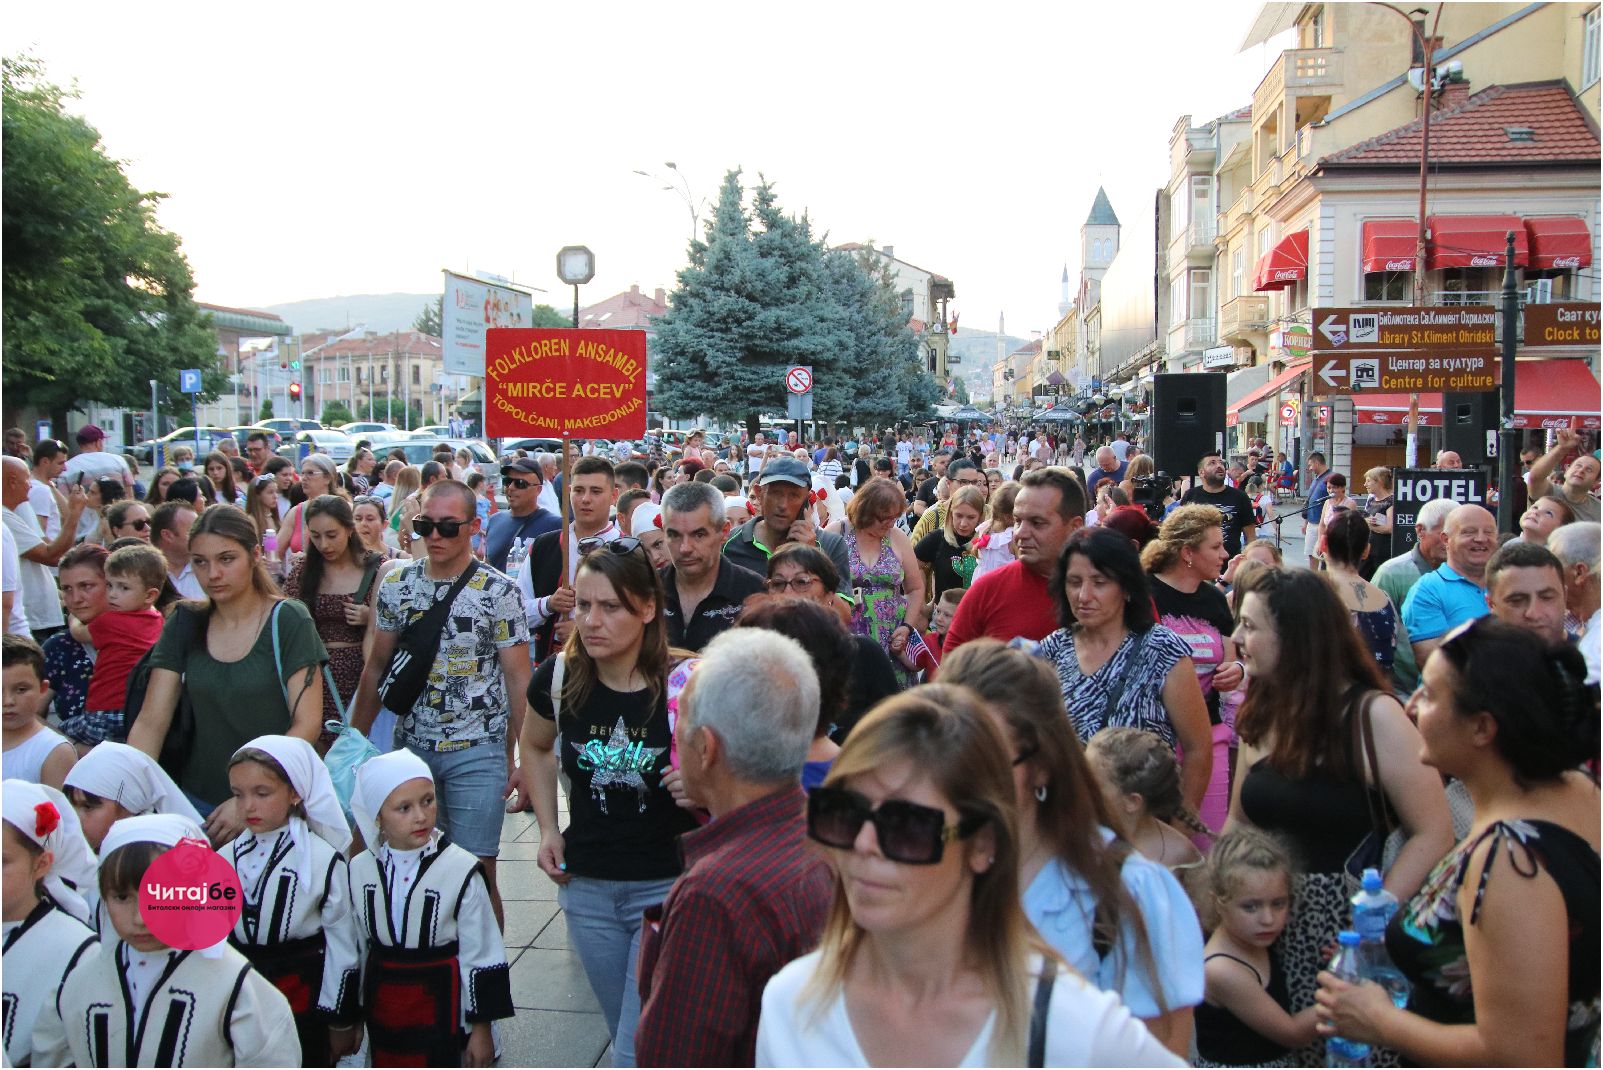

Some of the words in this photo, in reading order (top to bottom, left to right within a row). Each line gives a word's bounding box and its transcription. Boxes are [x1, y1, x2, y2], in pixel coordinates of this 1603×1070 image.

[1378, 312, 1419, 325] Библиотека
[1460, 311, 1495, 328] Охридски
[1557, 307, 1583, 322] Саат
[1585, 310, 1601, 325] ку
[1378, 330, 1409, 346] Library
[1411, 329, 1457, 344] St.Kliment
[1459, 329, 1495, 343] Ohridski
[1545, 326, 1580, 341] Clock
[1585, 326, 1601, 340] to
[487, 338, 570, 382] FOLKLOREN
[576, 339, 643, 383] ANSAMBL
[1388, 356, 1426, 373] Центар
[1428, 358, 1441, 369] за
[1443, 357, 1484, 373] култура
[185, 373, 197, 389] P
[1381, 375, 1424, 389] Centre
[1427, 375, 1445, 388] for
[1449, 375, 1493, 388] culture
[491, 394, 561, 431] TOPOLČANI,
[564, 397, 643, 430] MAKEDONIJA
[1397, 479, 1482, 502] HOTEL
[1396, 513, 1416, 525] БЕ
[590, 724, 648, 737] BELEVE
